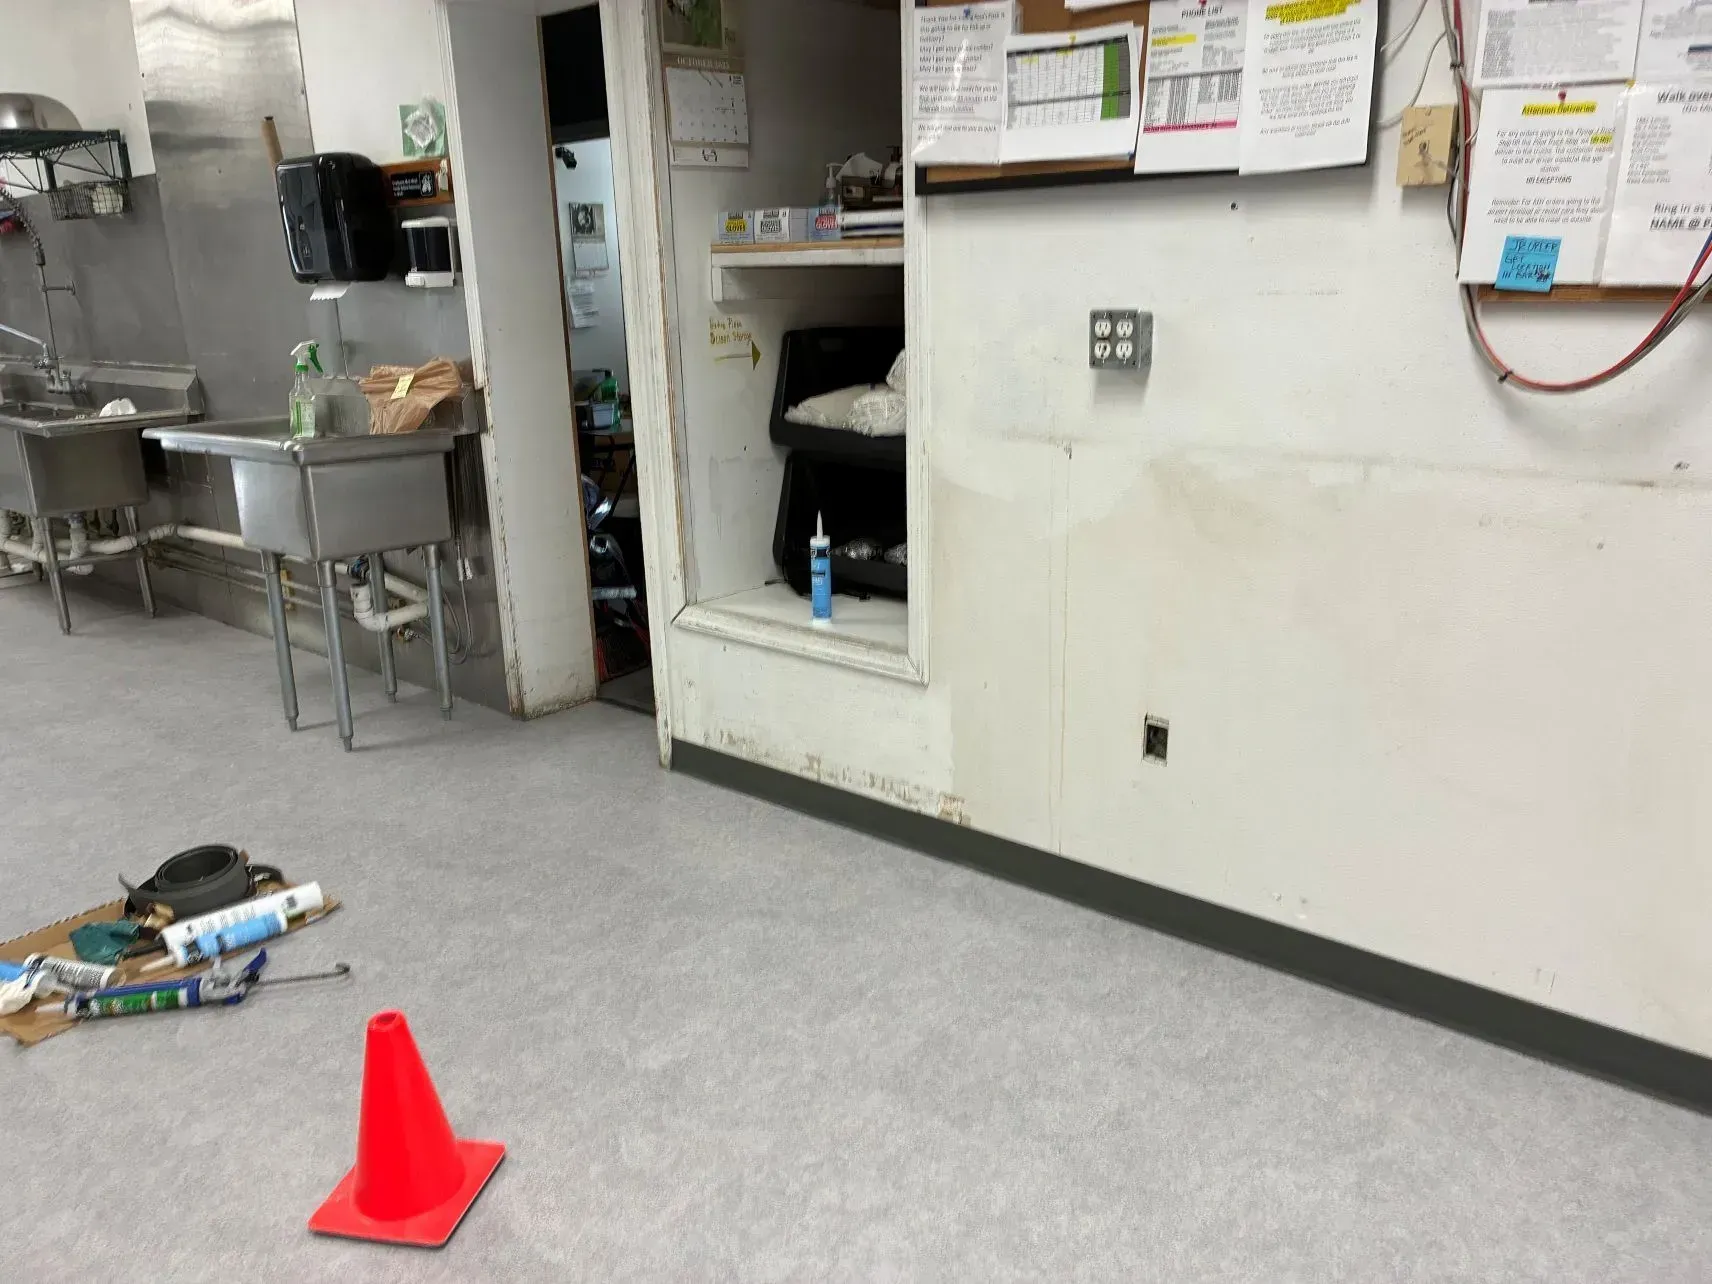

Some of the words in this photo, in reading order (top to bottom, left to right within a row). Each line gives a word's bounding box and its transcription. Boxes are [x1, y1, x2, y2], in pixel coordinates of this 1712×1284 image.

[1657, 90, 1686, 103] Walk
[1522, 104, 1556, 115] Attention
[1650, 218, 1684, 229] NAME
